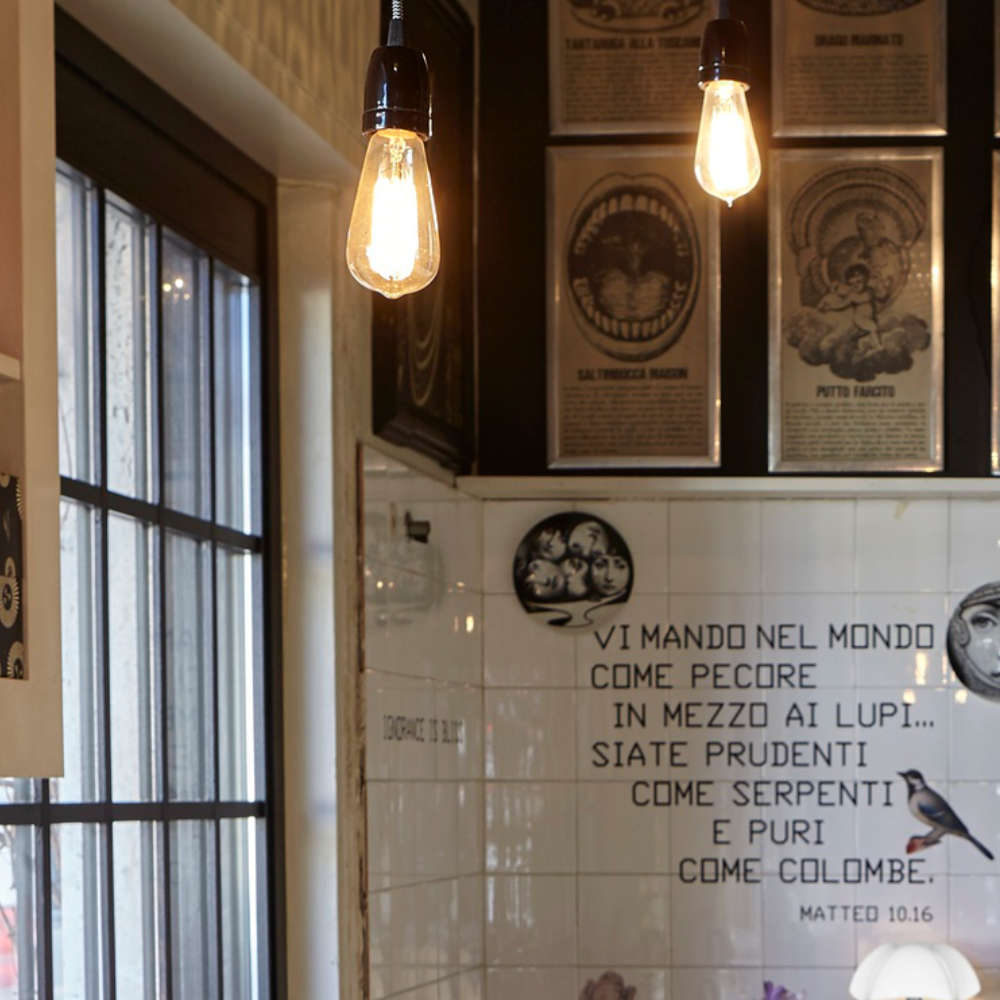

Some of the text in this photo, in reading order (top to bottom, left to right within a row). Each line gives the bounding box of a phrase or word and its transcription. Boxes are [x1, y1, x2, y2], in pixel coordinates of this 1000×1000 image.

[816, 385, 896, 398] PUTTO FARCITO
[594, 623, 934, 650] VI MANDO NEL MONDO
[591, 663, 817, 689] COME PECORE
[613, 702, 934, 728] IN MEZZO AI LUPI...
[591, 741, 867, 768] SIATE PRUDENTI
[631, 780, 893, 807] COME SERPENTI
[712, 819, 824, 845] E PURI
[679, 858, 934, 884] COME COLOMBE.
[800, 905, 934, 922] MATTEO 10.16
